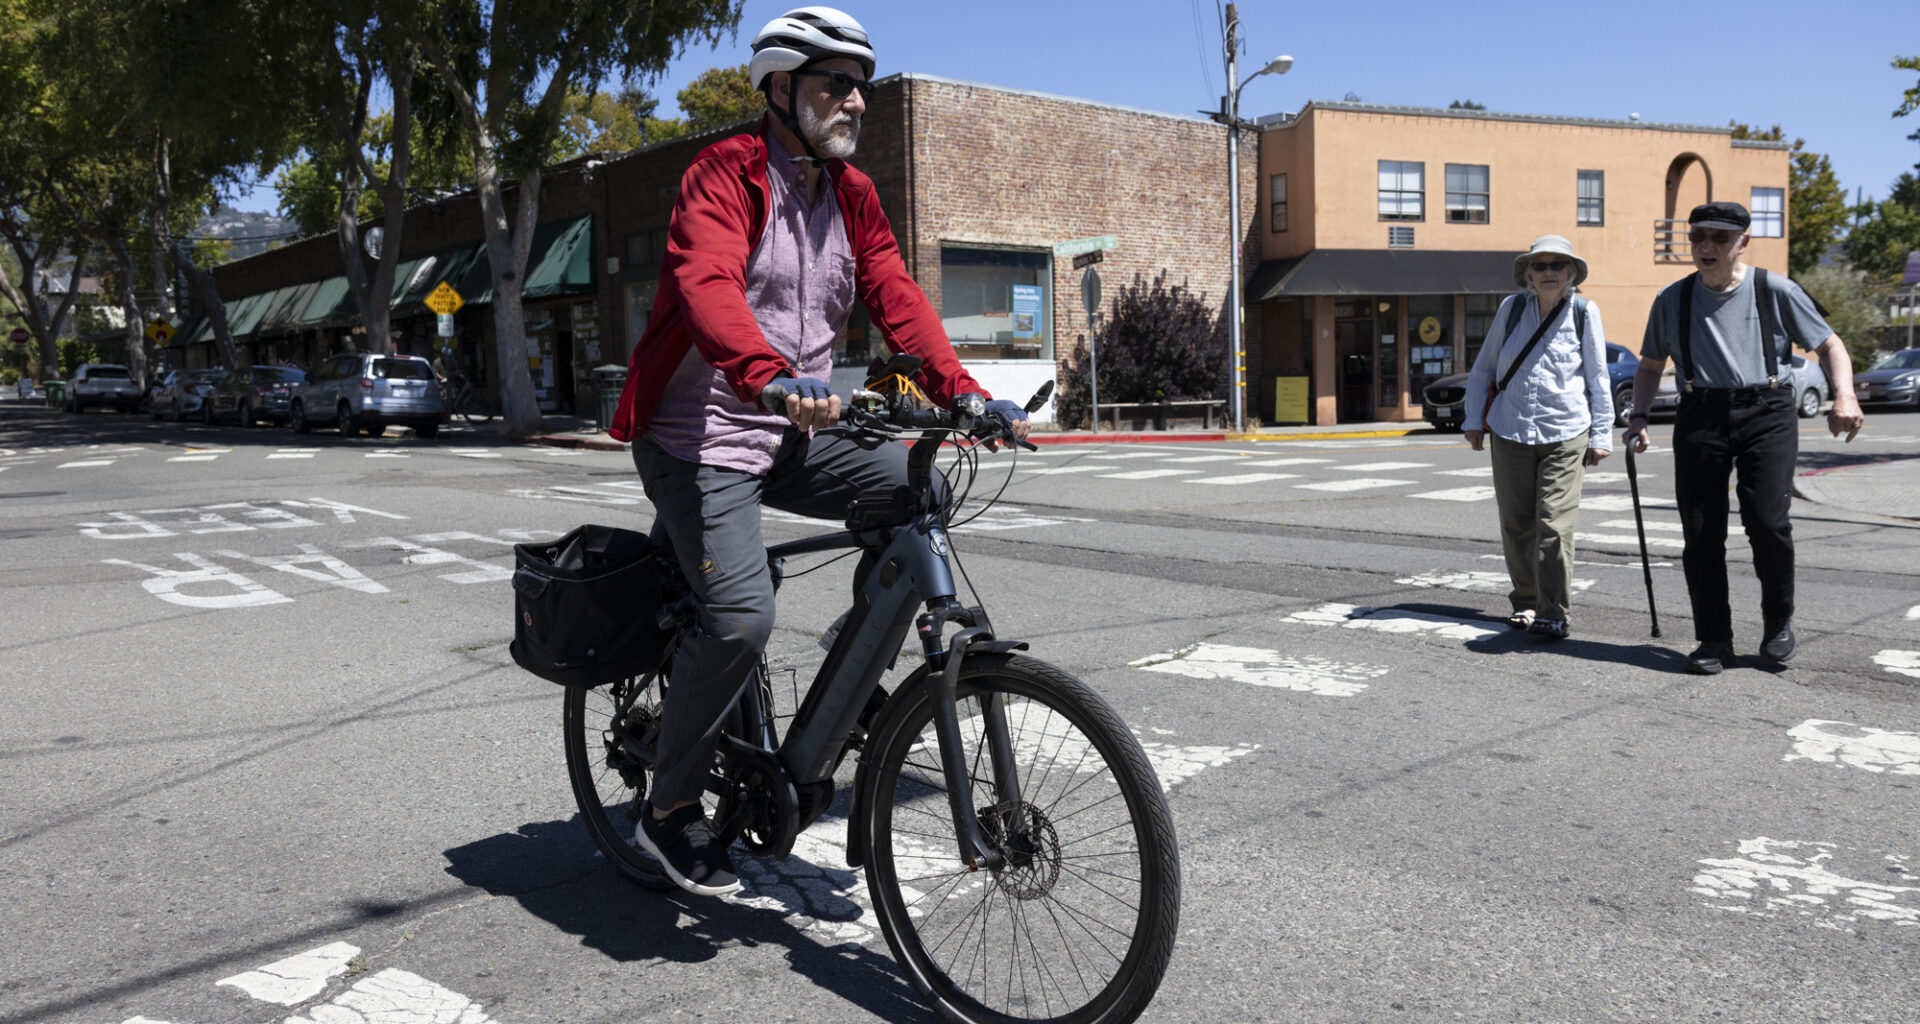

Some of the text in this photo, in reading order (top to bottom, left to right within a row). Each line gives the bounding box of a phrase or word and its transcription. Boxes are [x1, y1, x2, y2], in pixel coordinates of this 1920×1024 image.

[78, 497, 409, 539] KEEP
[101, 528, 567, 609] LEAR
[817, 622, 883, 729] GAZELLE
